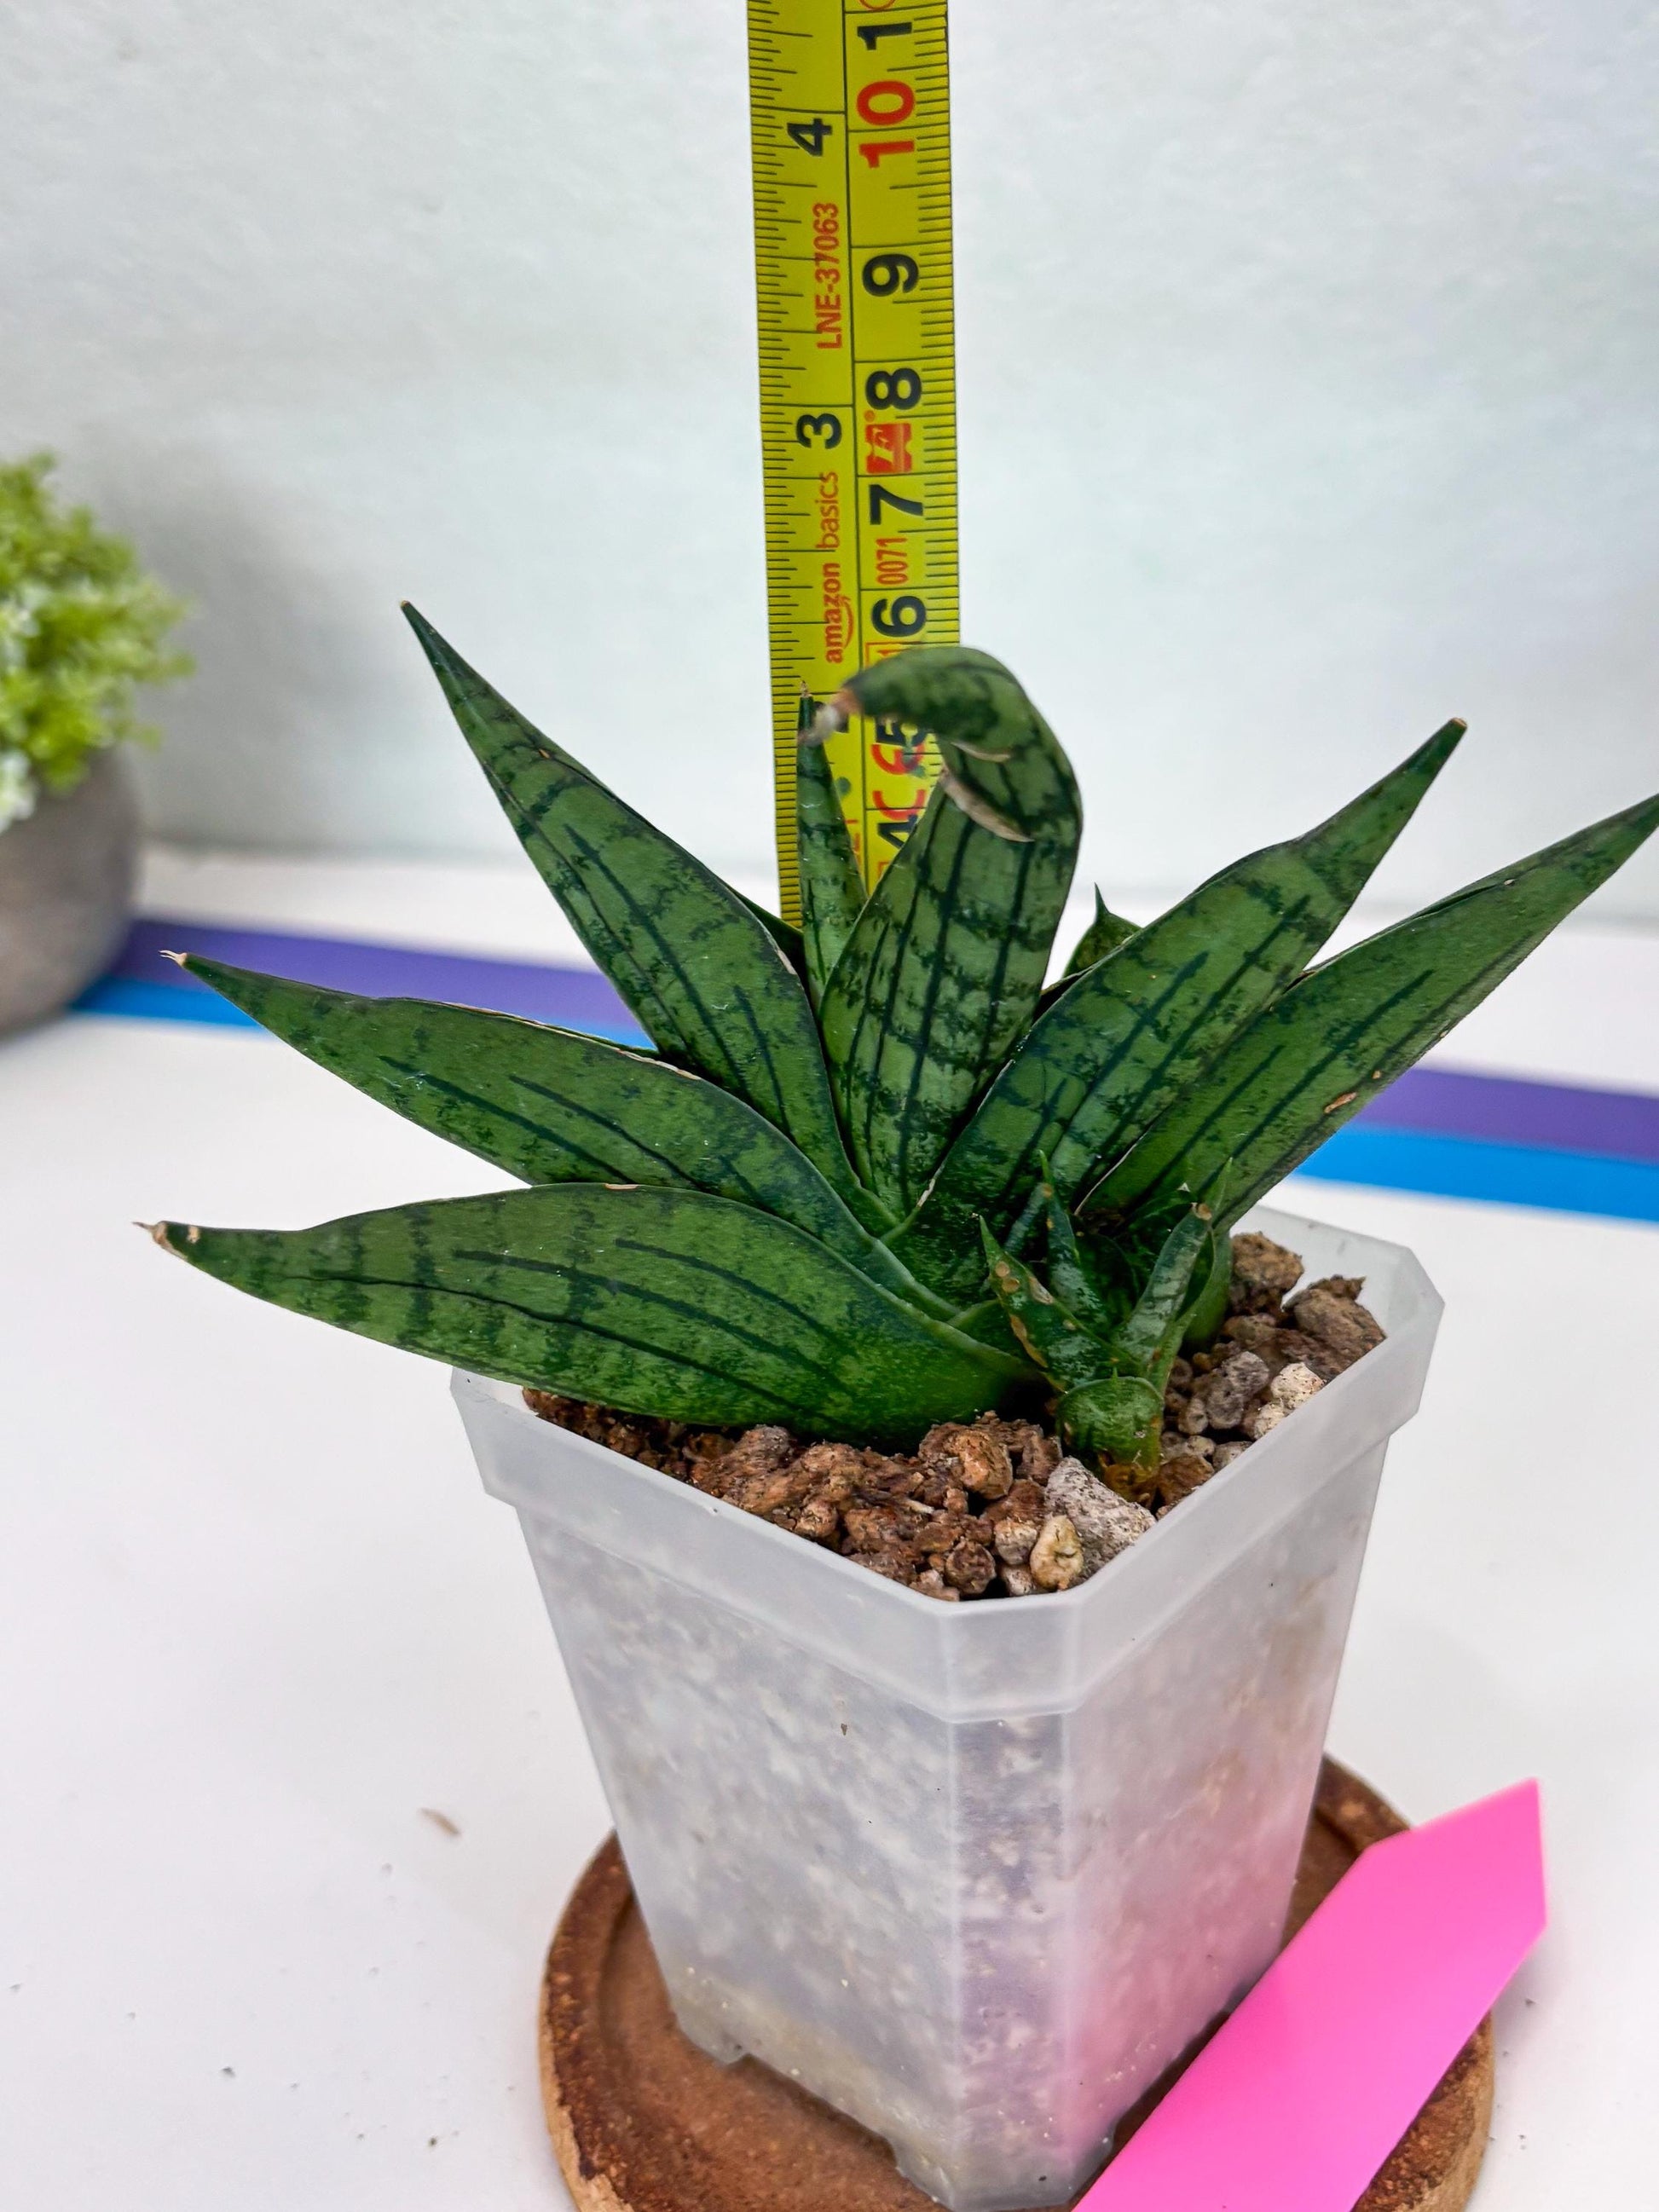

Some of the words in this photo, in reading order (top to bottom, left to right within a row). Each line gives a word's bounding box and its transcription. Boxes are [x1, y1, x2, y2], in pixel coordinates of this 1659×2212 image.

[786, 118, 832, 157] 4
[857, 80, 915, 169] 10
[812, 202, 842, 349] LNE-37063
[862, 253, 919, 297] 9
[865, 367, 922, 410] 8
[796, 413, 842, 449] 3
[815, 471, 840, 549] basics
[869, 484, 923, 525] 7
[876, 538, 909, 586] 0071
[822, 563, 844, 664] amazon
[871, 595, 927, 638] 6
